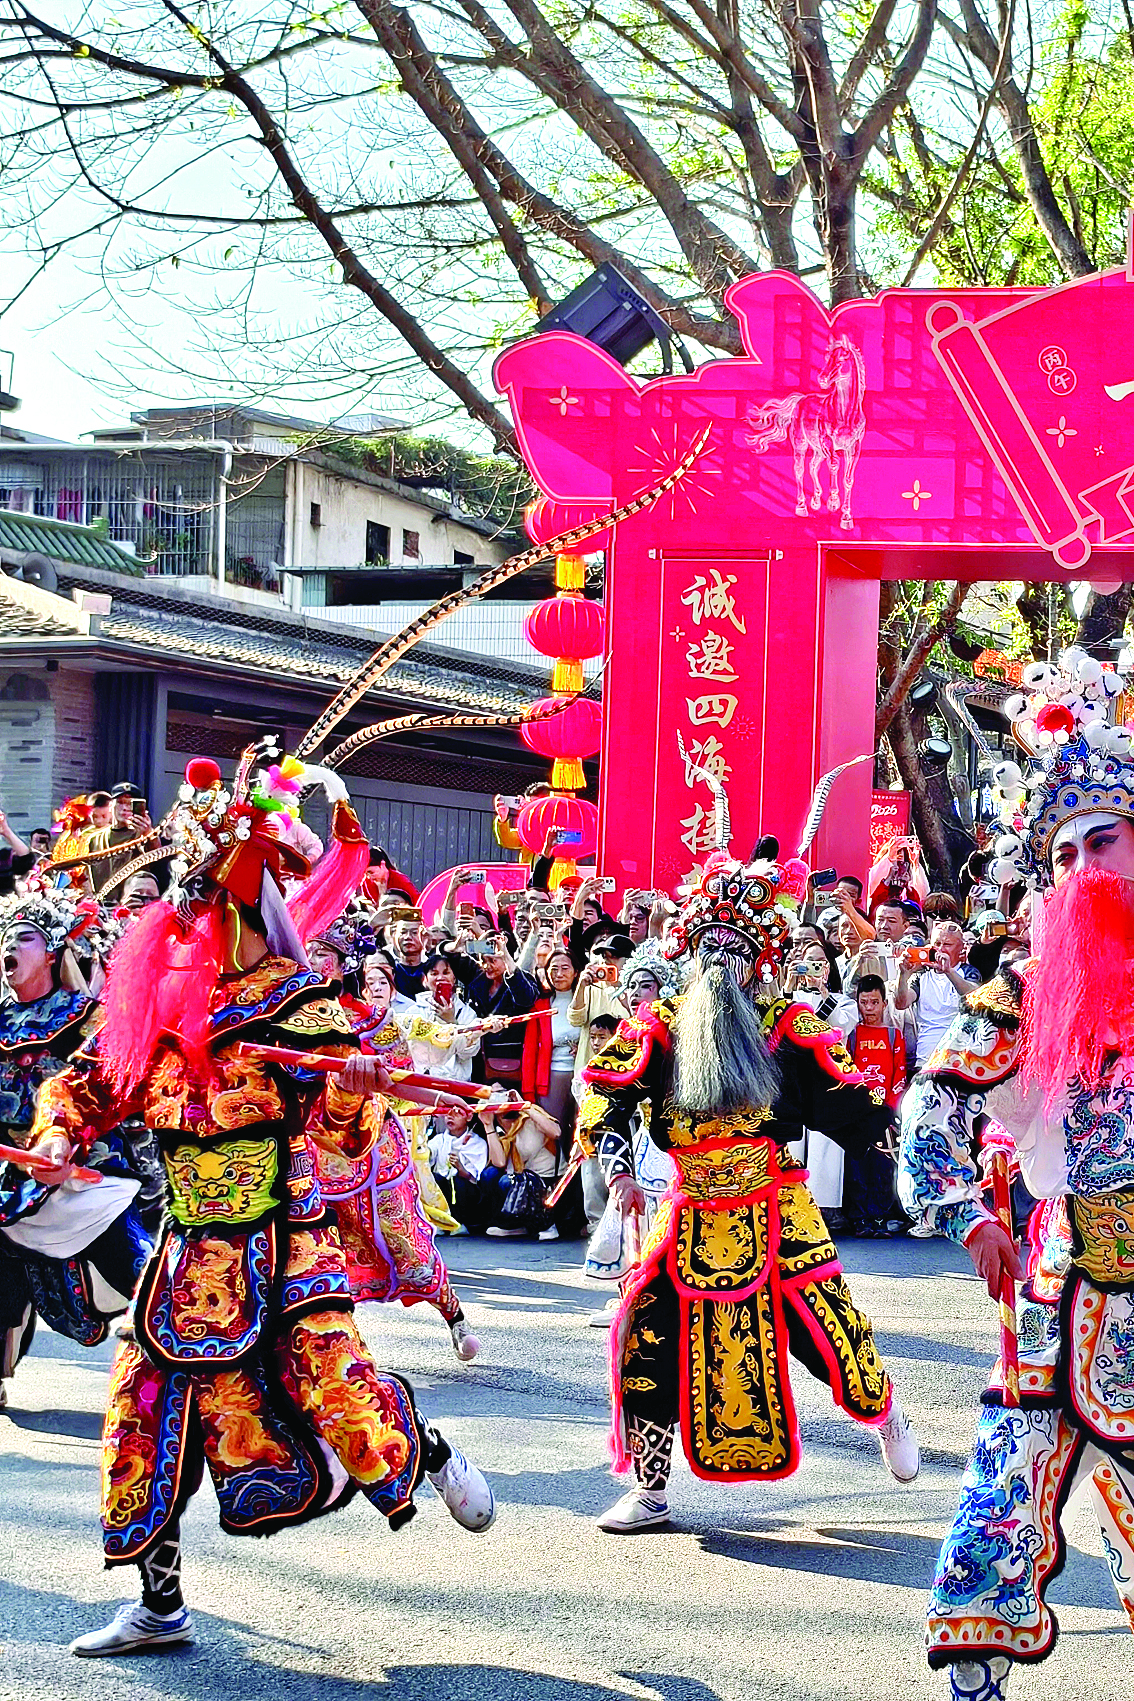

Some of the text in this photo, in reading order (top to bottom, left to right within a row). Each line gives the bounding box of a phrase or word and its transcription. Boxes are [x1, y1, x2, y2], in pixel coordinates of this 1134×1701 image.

[680, 568, 746, 893] 诚邀四海接
[859, 1040, 887, 1050] FILA
